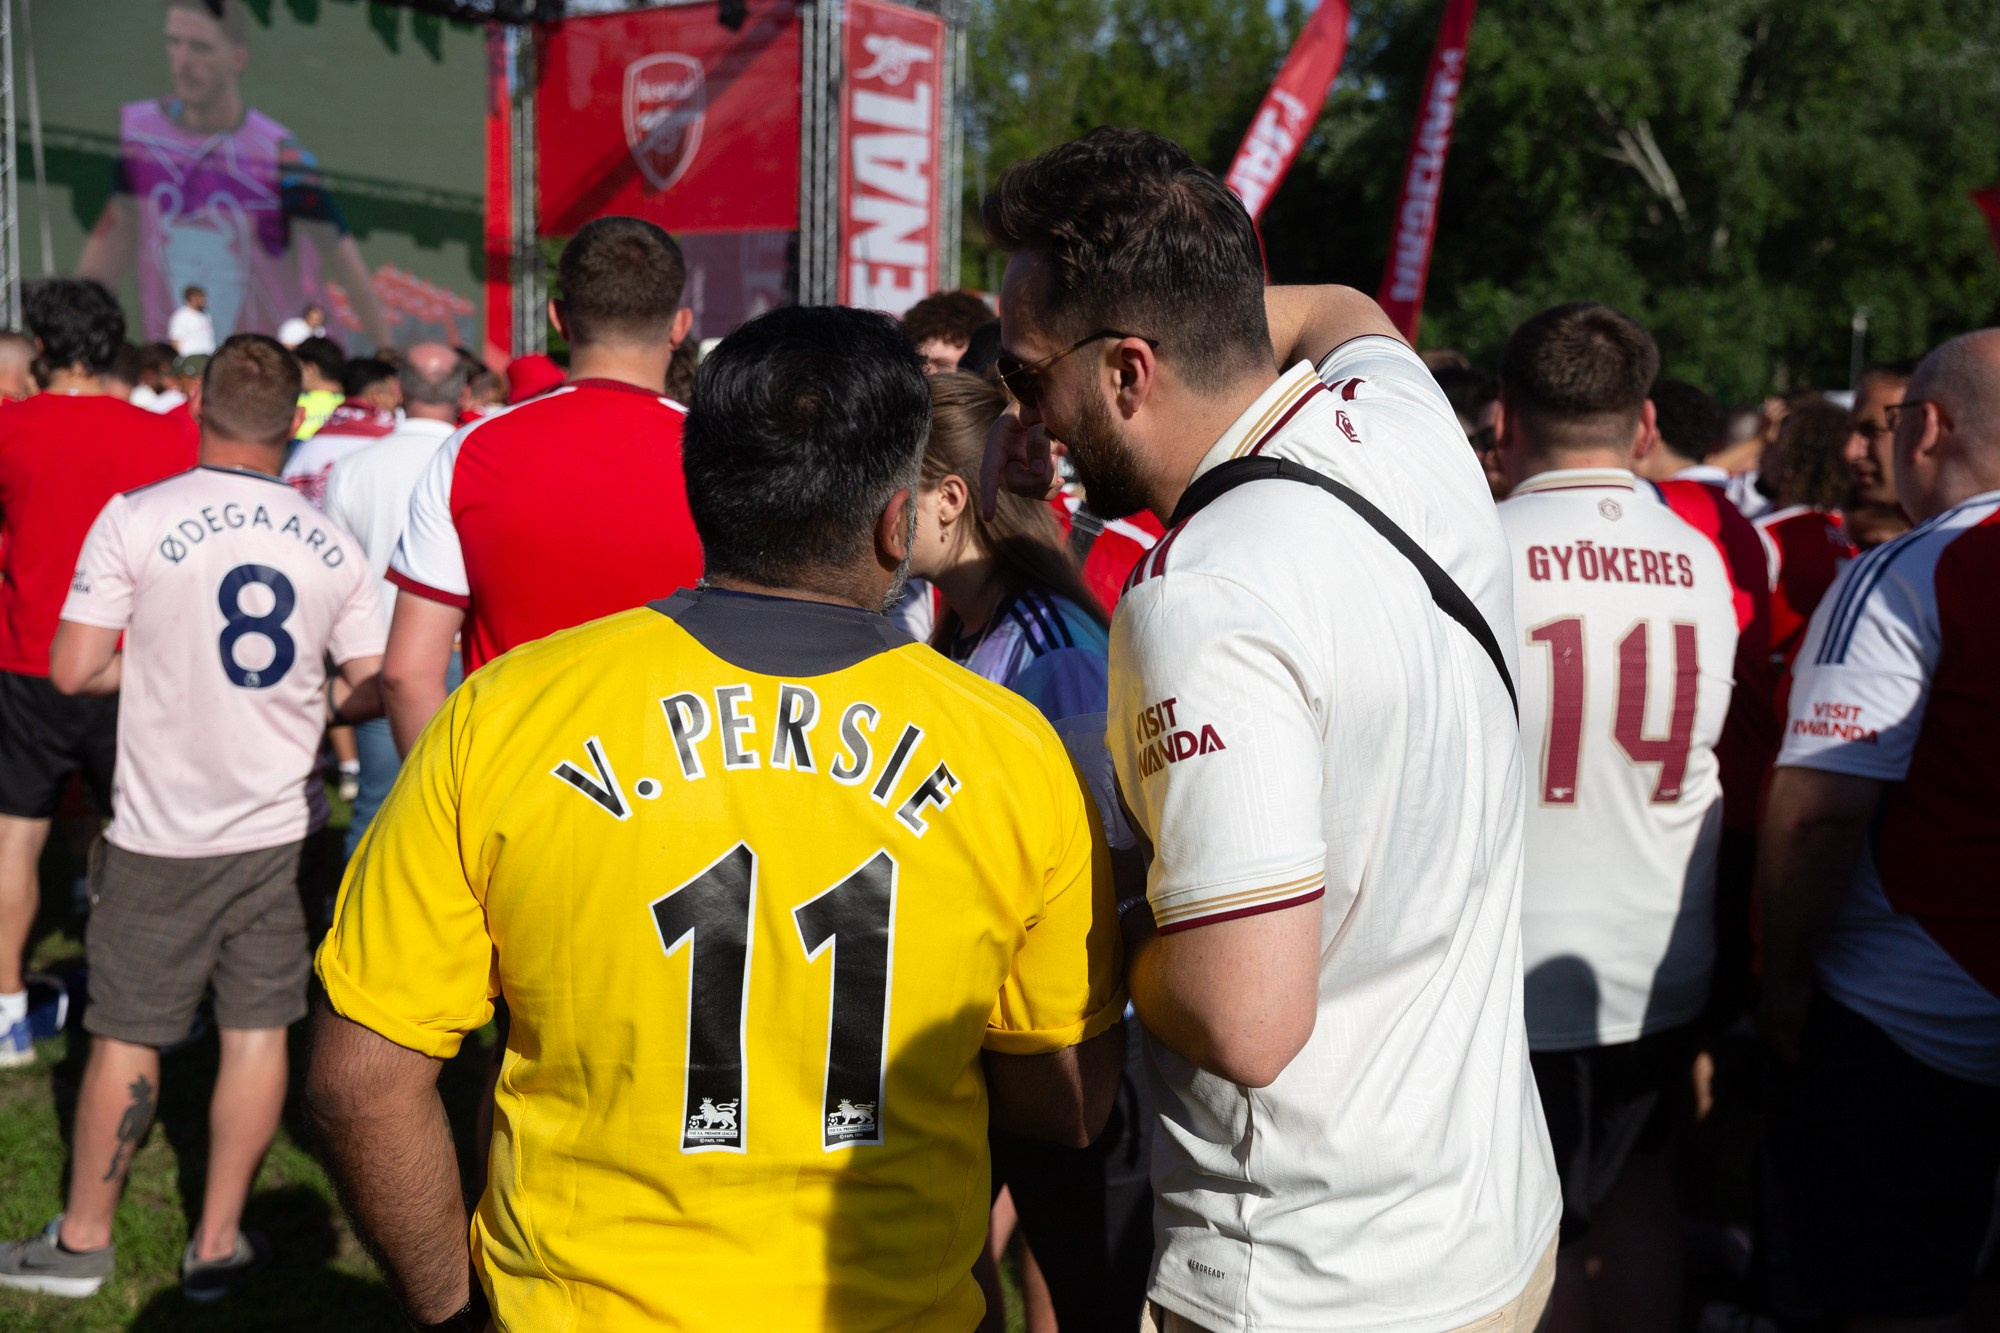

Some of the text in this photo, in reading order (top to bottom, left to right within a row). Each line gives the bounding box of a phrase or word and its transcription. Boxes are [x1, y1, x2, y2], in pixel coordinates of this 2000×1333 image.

[160, 504, 344, 568] ØDEGAARD
[1527, 540, 1693, 588] GYÖKERES
[217, 563, 296, 689] 8
[1136, 697, 1177, 745] VISIT
[1525, 613, 1700, 808] 14
[1813, 703, 1863, 721] VISIT
[550, 683, 961, 838] V. PERSIE
[1138, 723, 1226, 784] WANDA
[649, 839, 899, 1155] 11
